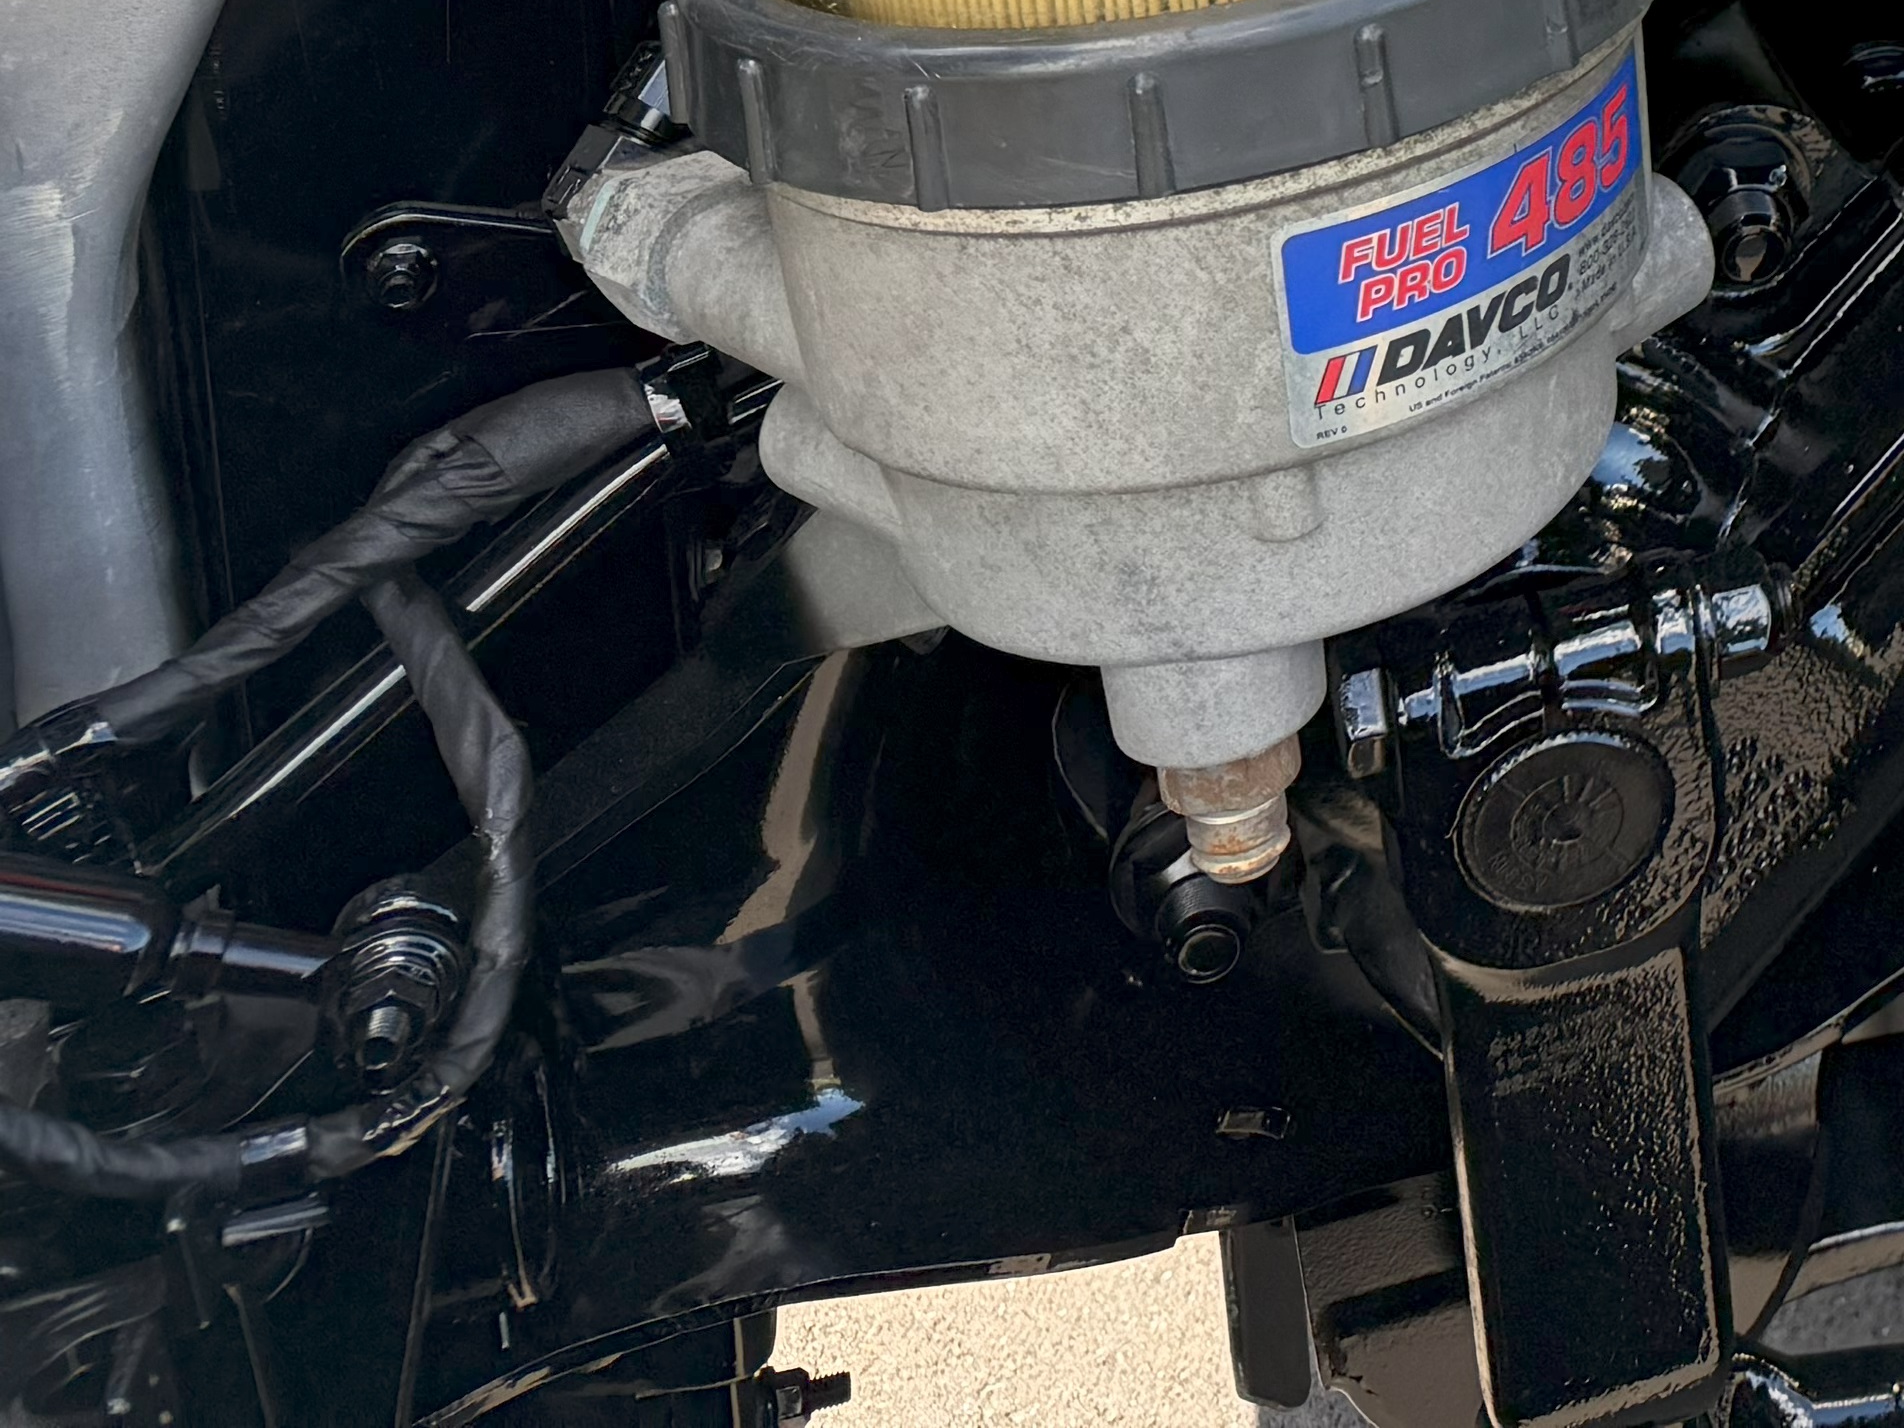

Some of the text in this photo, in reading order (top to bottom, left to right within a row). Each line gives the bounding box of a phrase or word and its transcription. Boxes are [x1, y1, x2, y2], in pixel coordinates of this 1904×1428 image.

[1338, 201, 1471, 285] FUEL
[1486, 81, 1630, 260] 485
[1356, 248, 1468, 324] PRO
[1376, 252, 1572, 387] DAVCO
[1408, 398, 1424, 414] US
[1425, 390, 1443, 409] and
[1444, 377, 1479, 398] Foreign
[1316, 427, 1338, 442] REV
